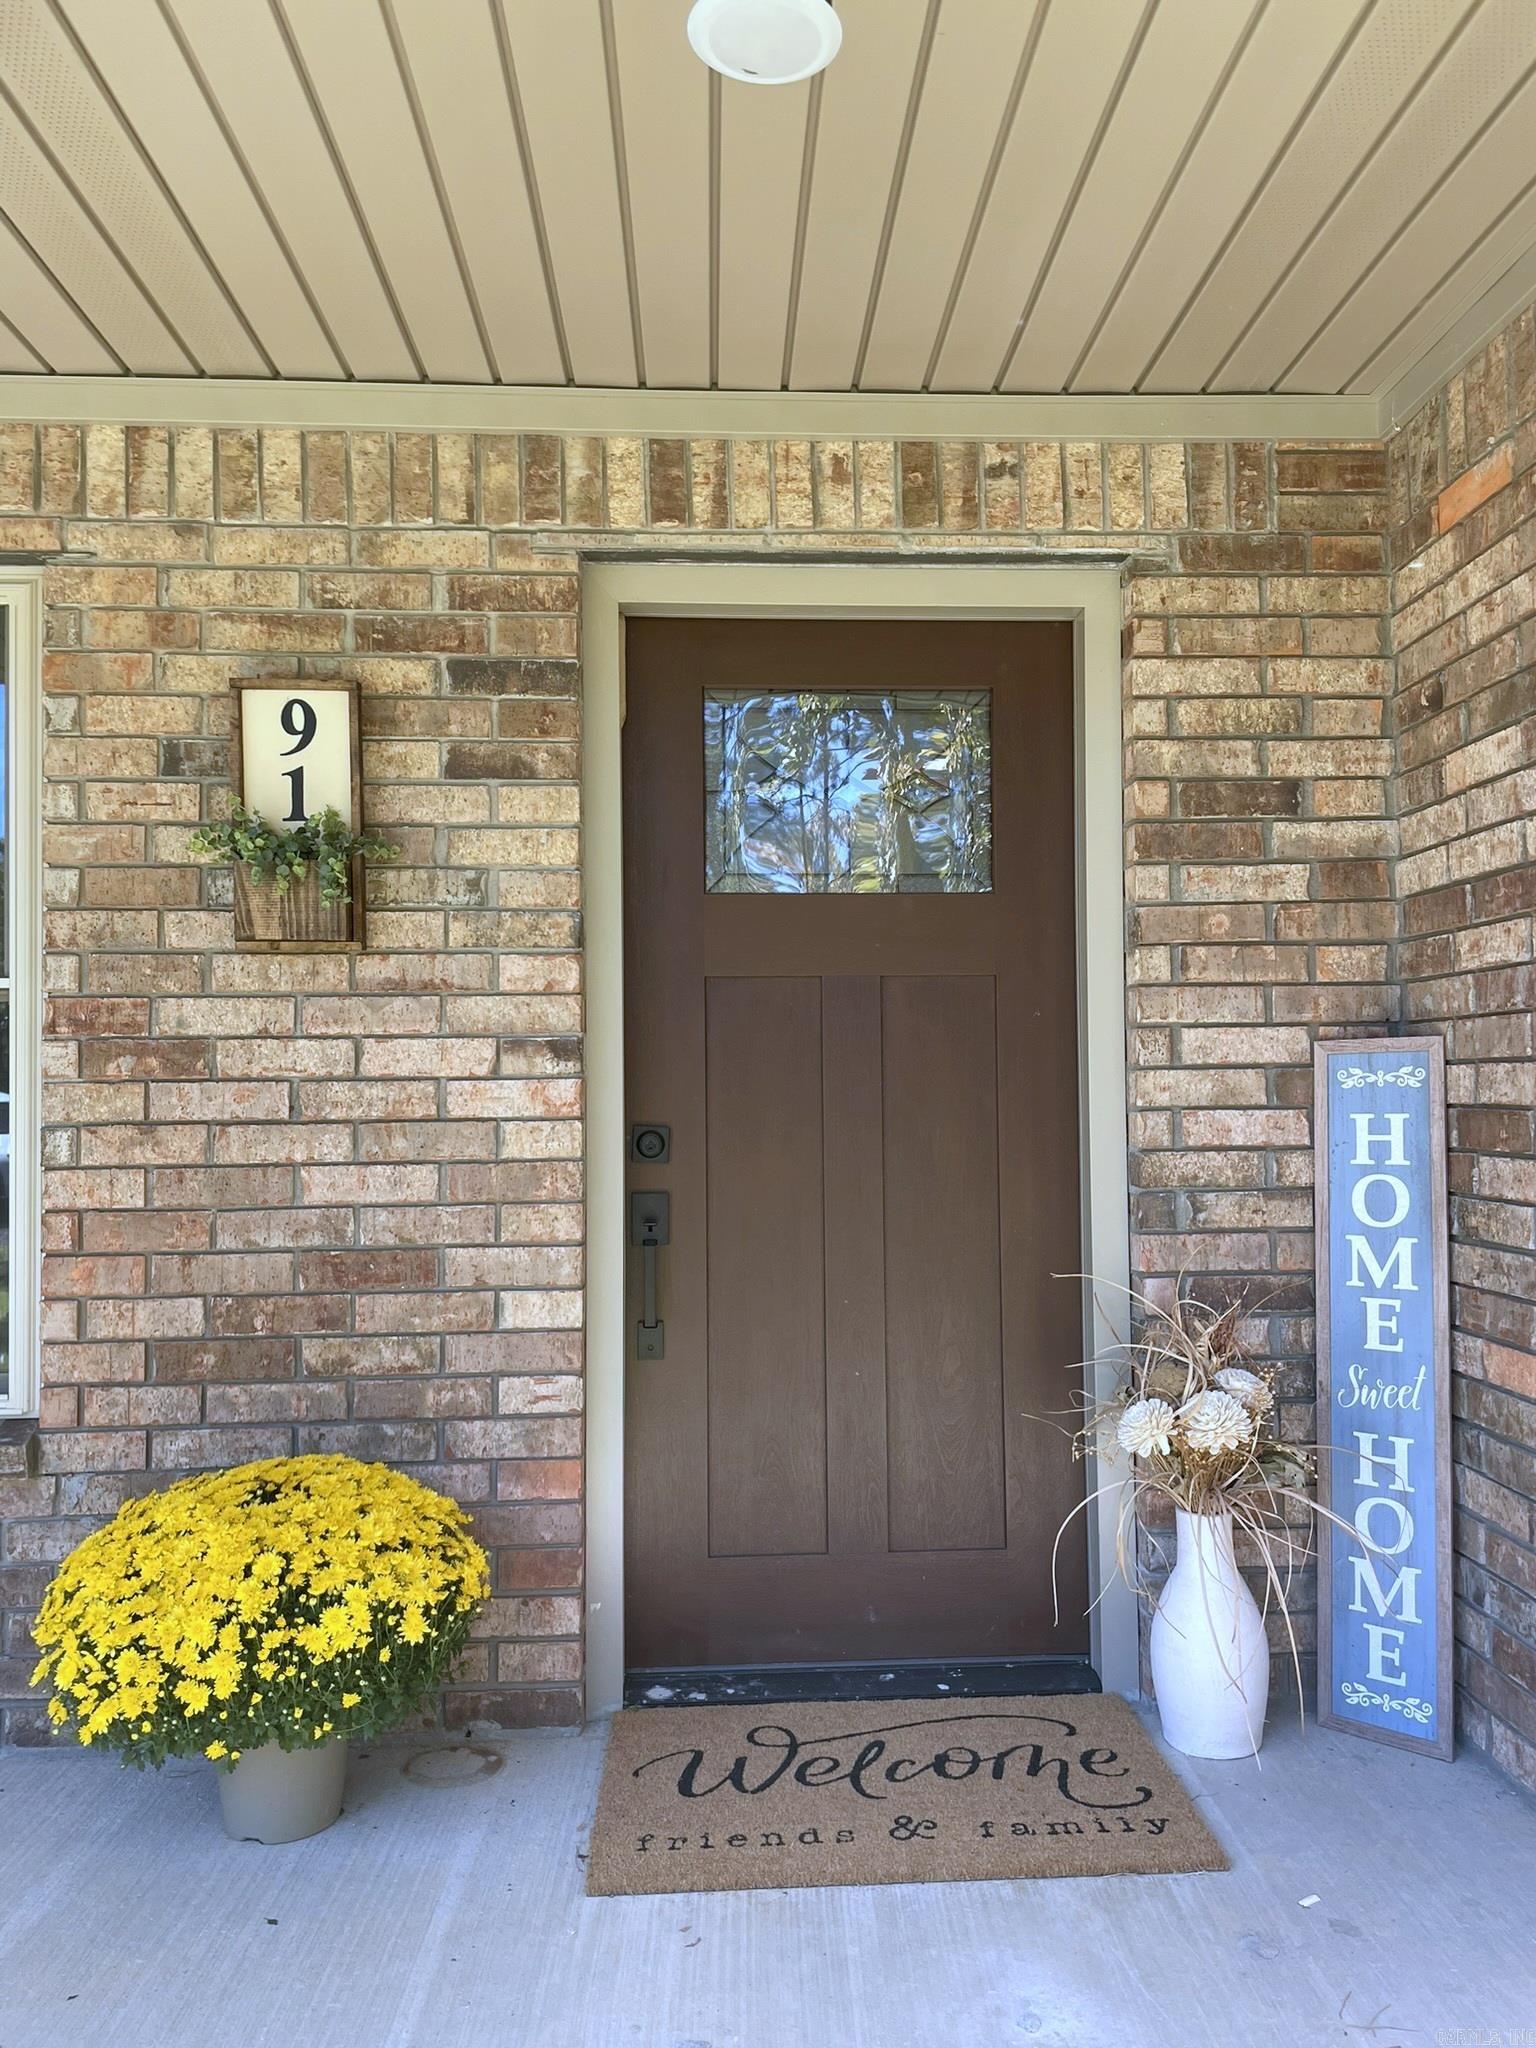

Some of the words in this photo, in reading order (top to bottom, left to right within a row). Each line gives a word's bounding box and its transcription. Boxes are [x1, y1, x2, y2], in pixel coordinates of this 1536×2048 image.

[279, 697, 318, 822] 91
[1344, 1112, 1419, 1353] HOME
[1337, 1363, 1428, 1412] Sweet
[1347, 1430, 1423, 1688] HOME
[632, 1714, 1153, 1809] Welcome
[636, 1827, 855, 1851] friends
[889, 1815, 938, 1841] &
[979, 1817, 1171, 1838] family
